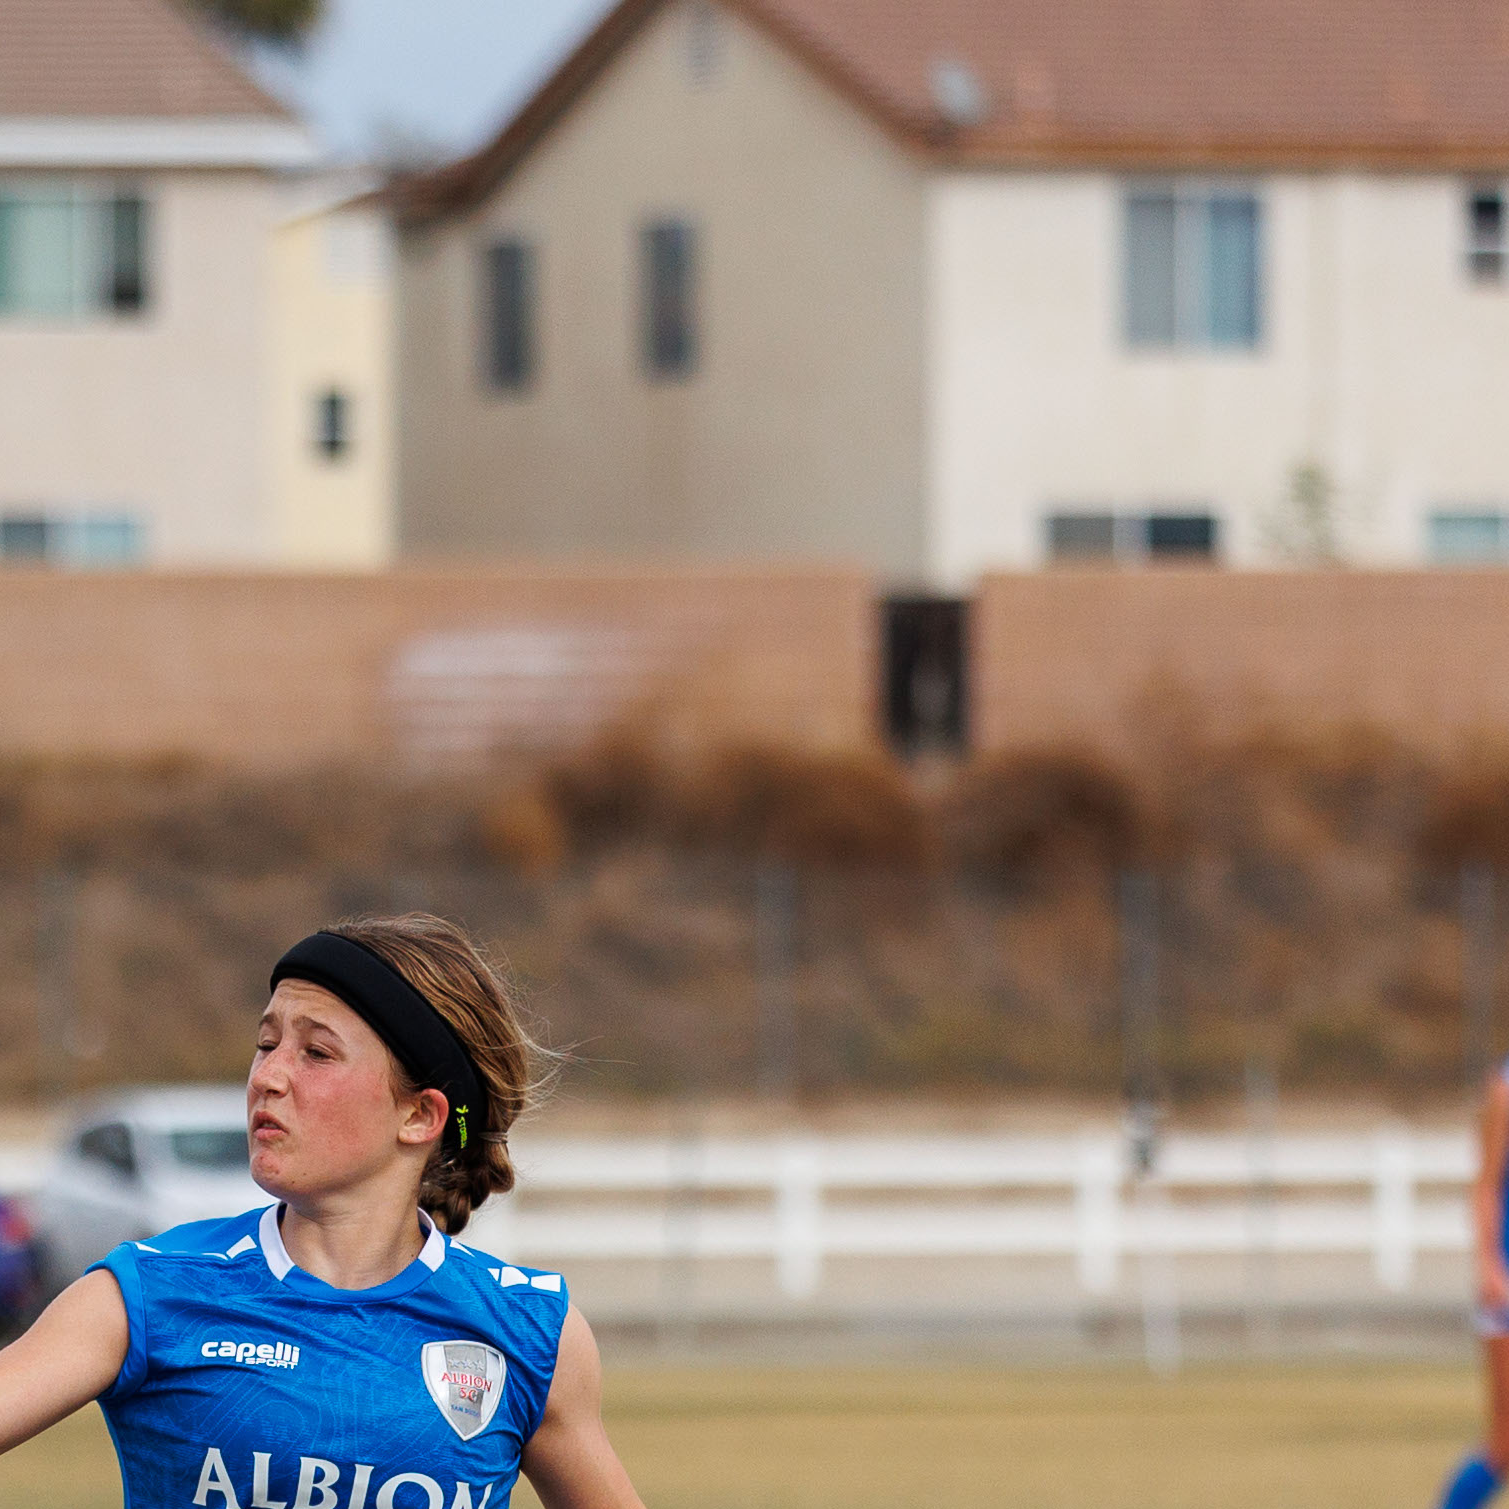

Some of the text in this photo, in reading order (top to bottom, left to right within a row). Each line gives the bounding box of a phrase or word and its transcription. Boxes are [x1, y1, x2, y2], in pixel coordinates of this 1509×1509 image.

[201, 1341, 300, 1363] capelli
[245, 1357, 298, 1370] SPORT
[441, 1372, 493, 1392] ALBION
[459, 1387, 478, 1402] SC
